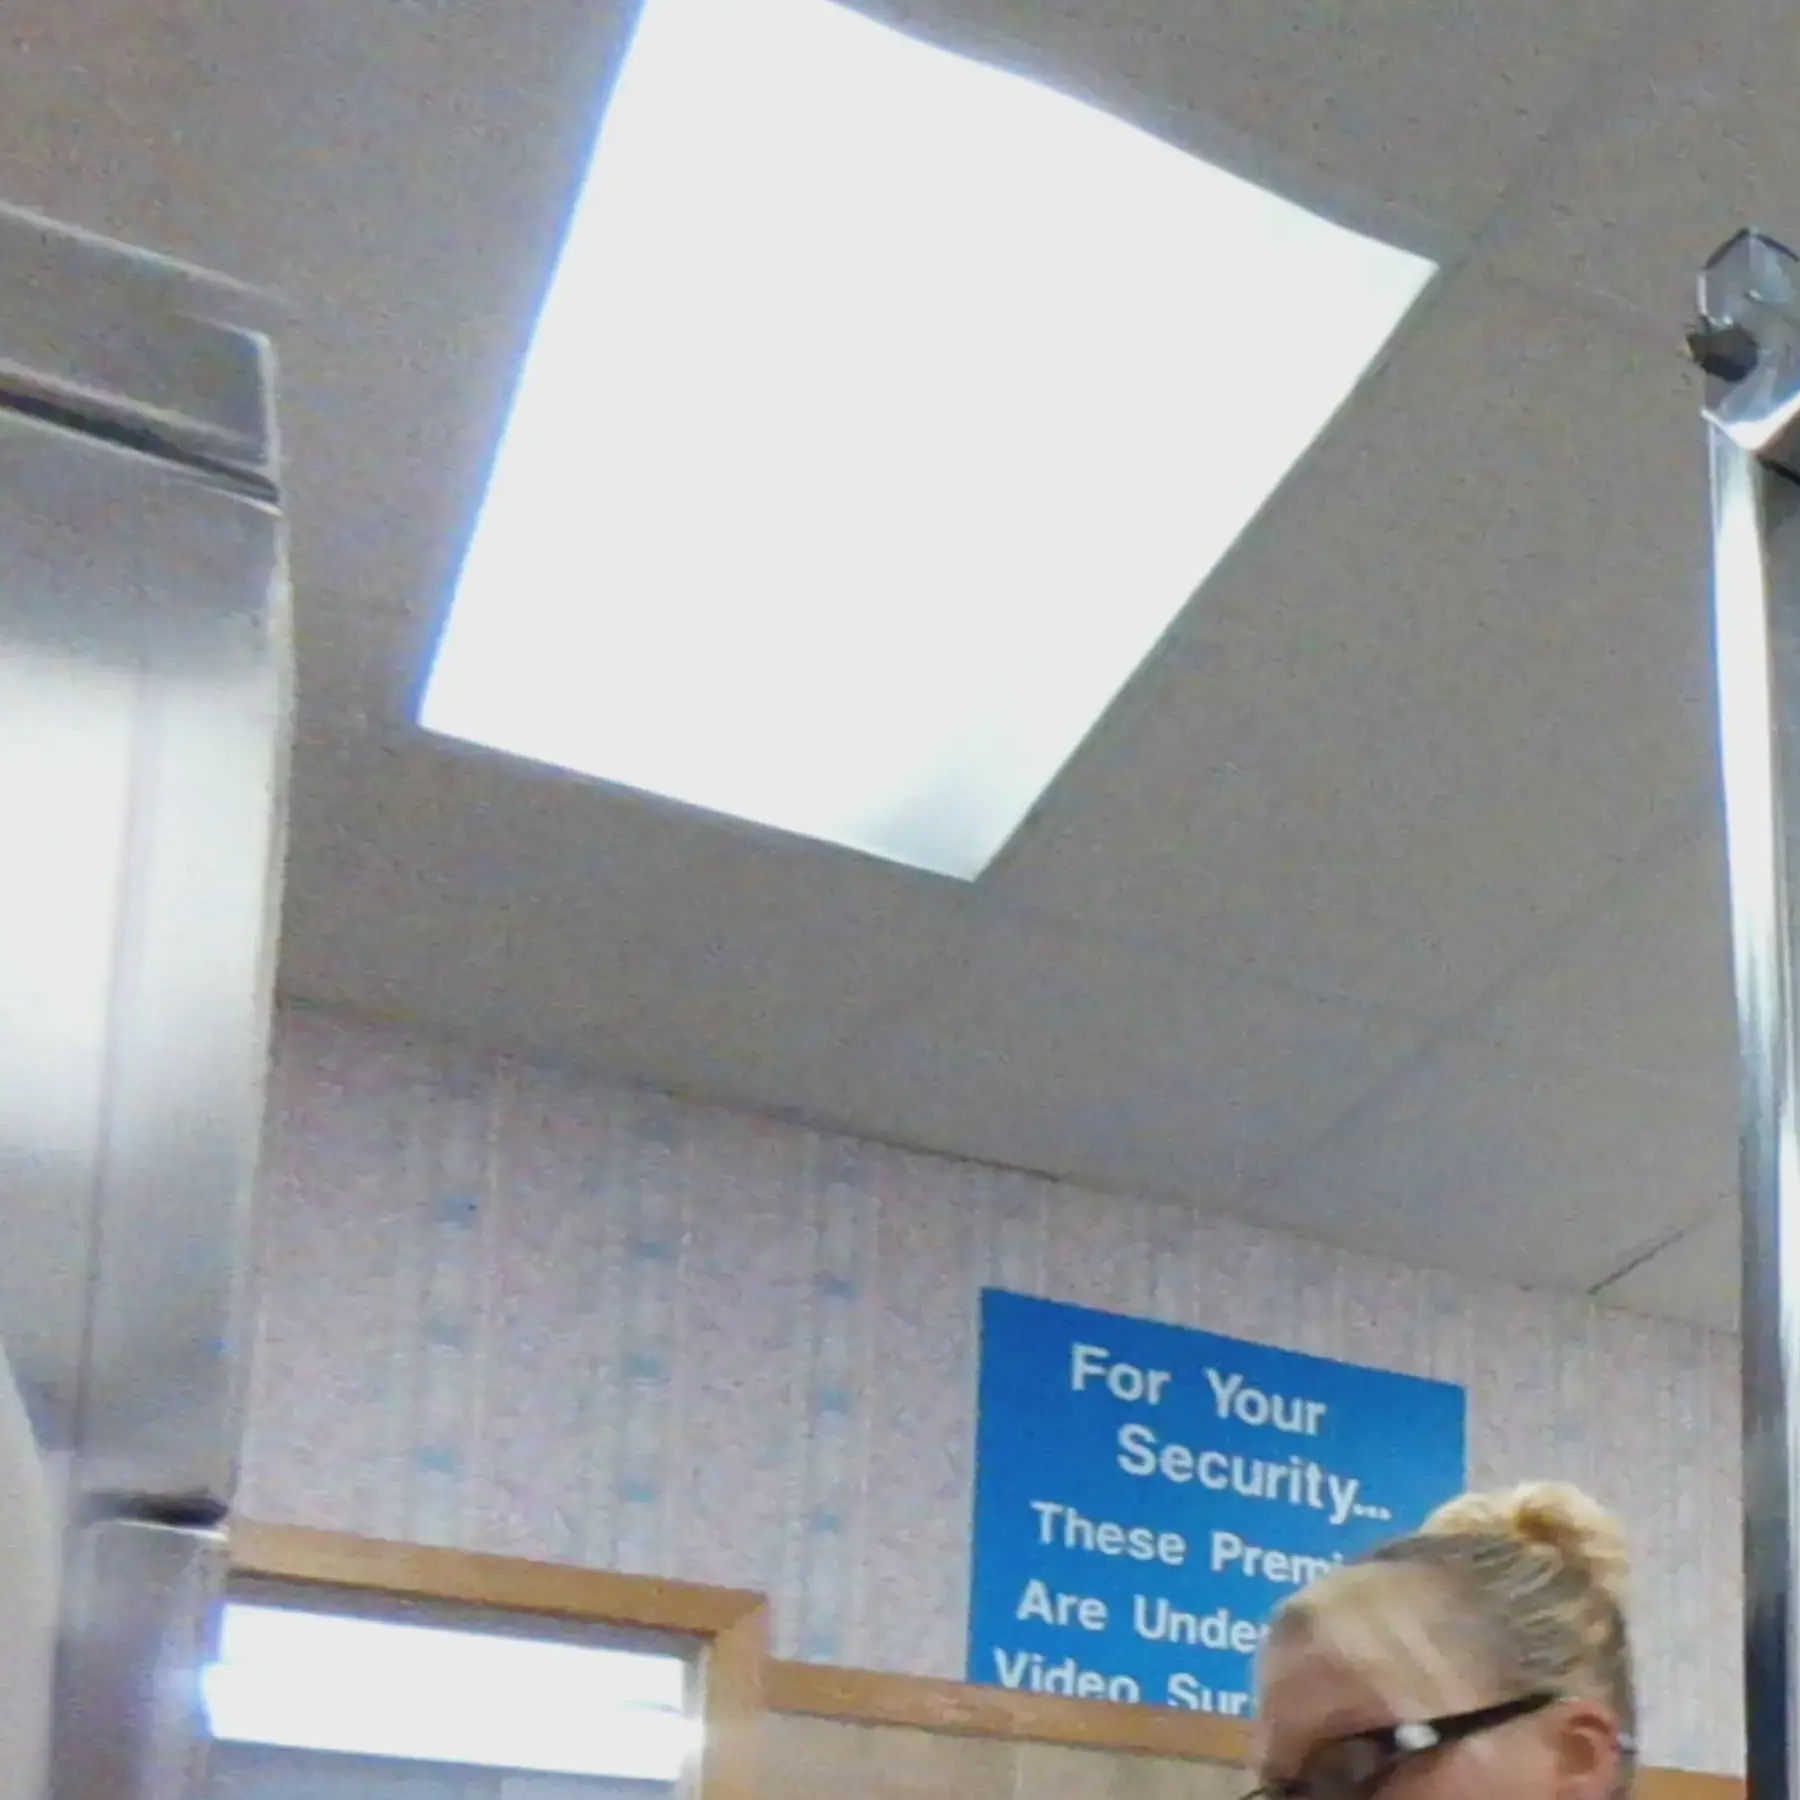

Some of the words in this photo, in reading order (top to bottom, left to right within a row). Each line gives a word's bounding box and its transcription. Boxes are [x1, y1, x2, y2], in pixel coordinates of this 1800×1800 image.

[1071, 1342, 1172, 1405] For
[1203, 1366, 1328, 1436] Your
[1116, 1422, 1393, 1525] Security...
[1030, 1501, 1186, 1565] These
[1016, 1578, 1109, 1630] Are
[994, 1647, 1139, 1704] Video
